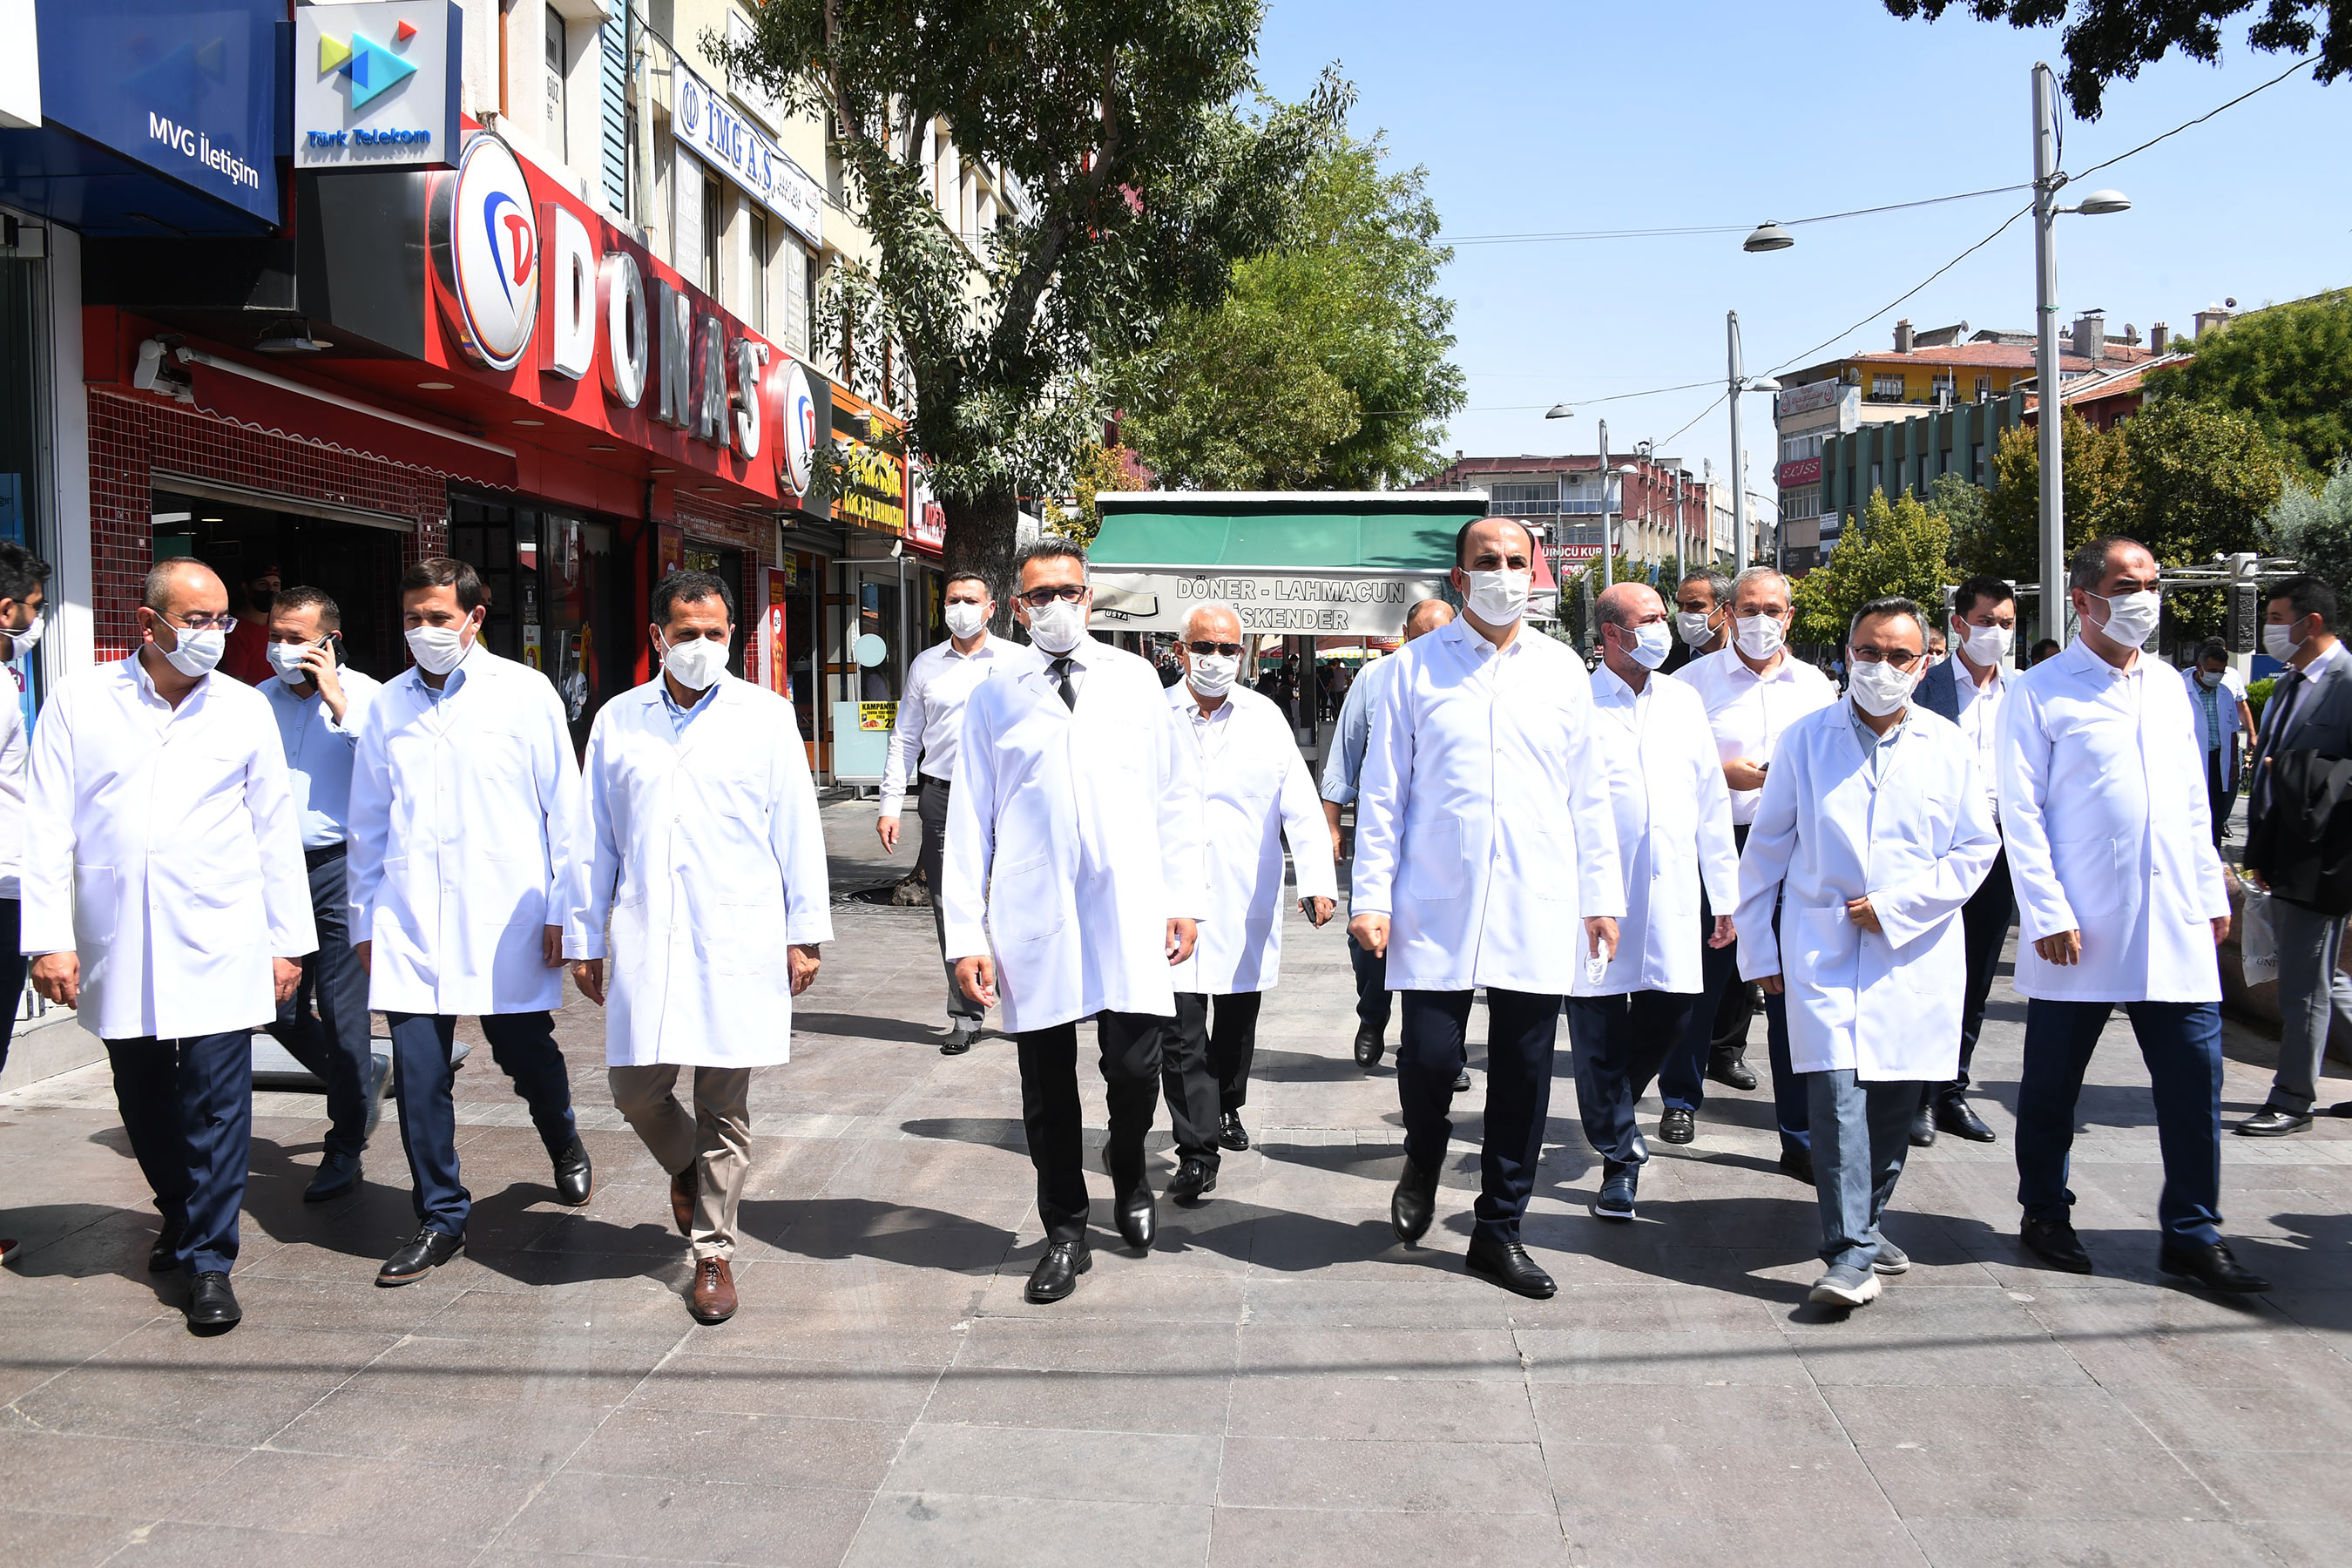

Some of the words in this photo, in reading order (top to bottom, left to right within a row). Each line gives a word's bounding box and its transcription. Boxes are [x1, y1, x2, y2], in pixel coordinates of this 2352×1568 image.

[150, 111, 195, 157] MVG
[200, 132, 259, 190] İletişim
[307, 130, 348, 147] Türk
[353, 127, 431, 145] Telekom
[540, 202, 761, 462] DONAS
[873, 500, 904, 530] LAHMACUN
[1543, 546, 1578, 558] ÜRÜCÜ
[1581, 547, 1617, 558] KURU
[1177, 575, 1256, 599] DÖNER
[1275, 579, 1406, 604] LAHMACUN
[1105, 611, 1127, 619] USTA
